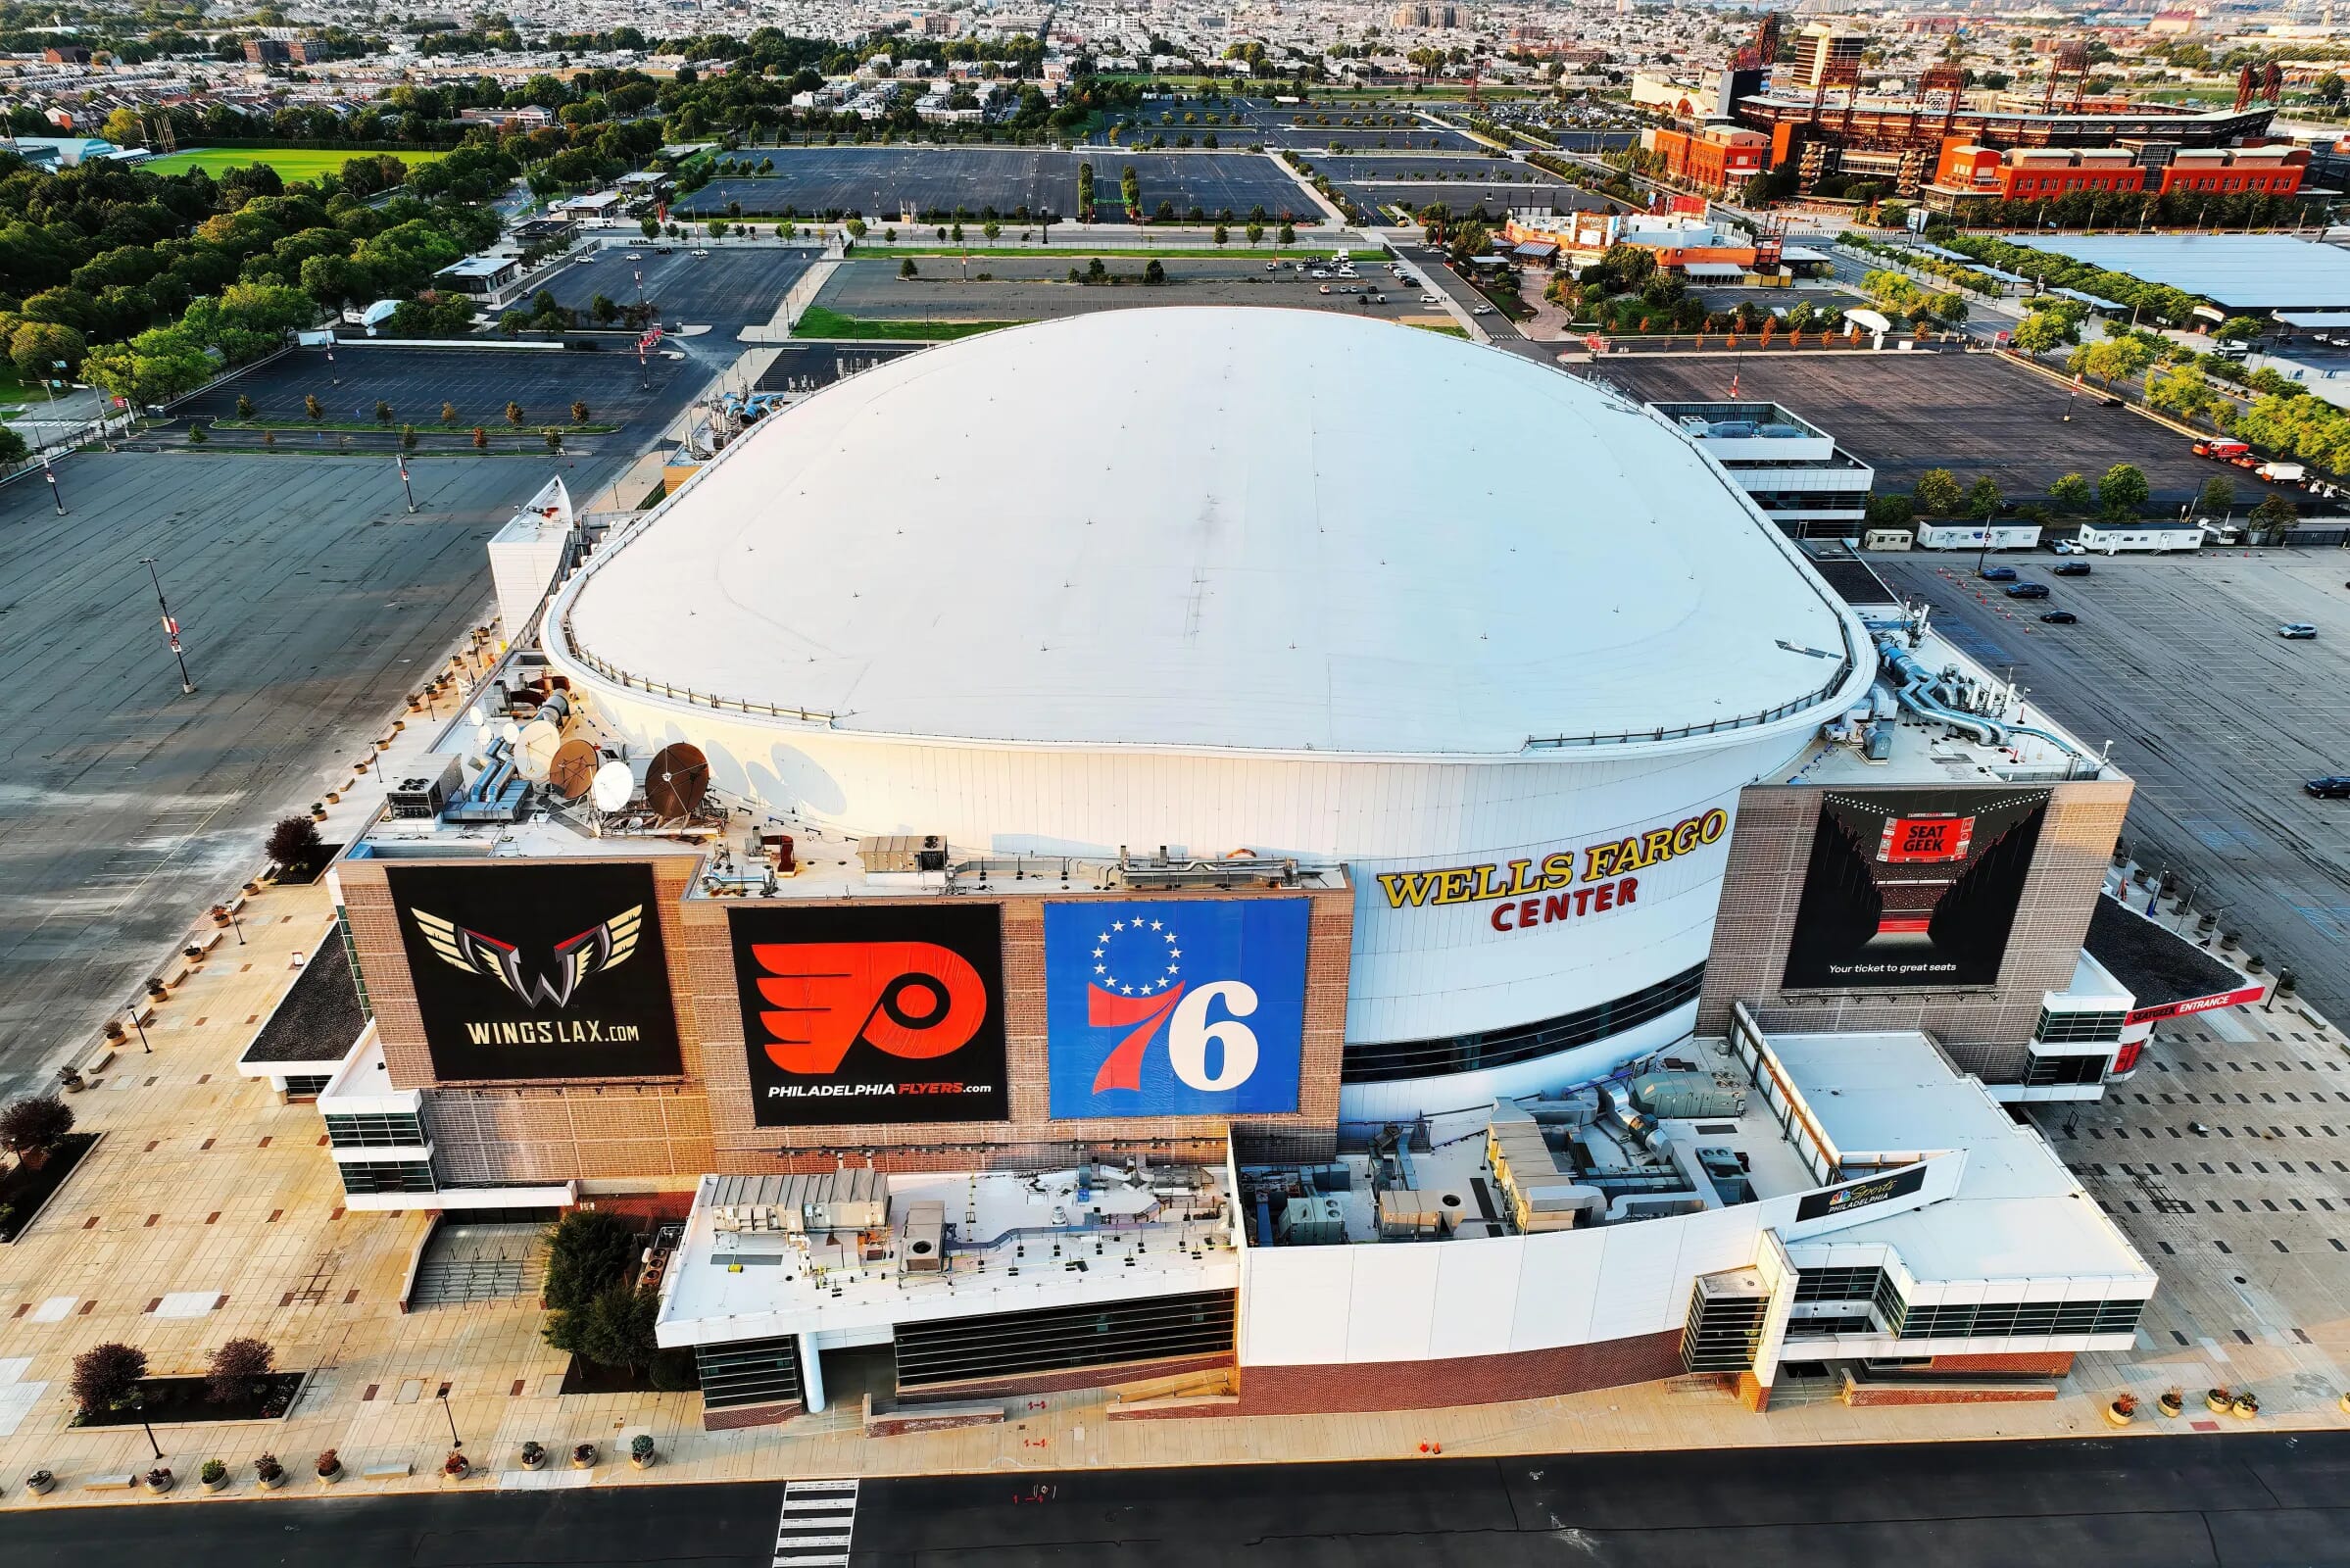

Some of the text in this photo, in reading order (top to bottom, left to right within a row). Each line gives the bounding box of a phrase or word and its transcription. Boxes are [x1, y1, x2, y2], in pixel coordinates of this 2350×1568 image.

[1908, 825, 1948, 839] SEAT
[1903, 839, 1945, 853] GEEK
[1378, 808, 1729, 908] WELLS FARGO
[1491, 876, 1639, 932] CENTER
[1830, 962, 1957, 974] Your ticket to great seats
[2179, 996, 2230, 1013] ENTRANCE
[1088, 979, 1259, 1095] 76
[768, 1083, 896, 1098] PHILADELPHIA
[1851, 1179, 1897, 1201] Sports
[1828, 1192, 1888, 1213] PHILADELPHIA
